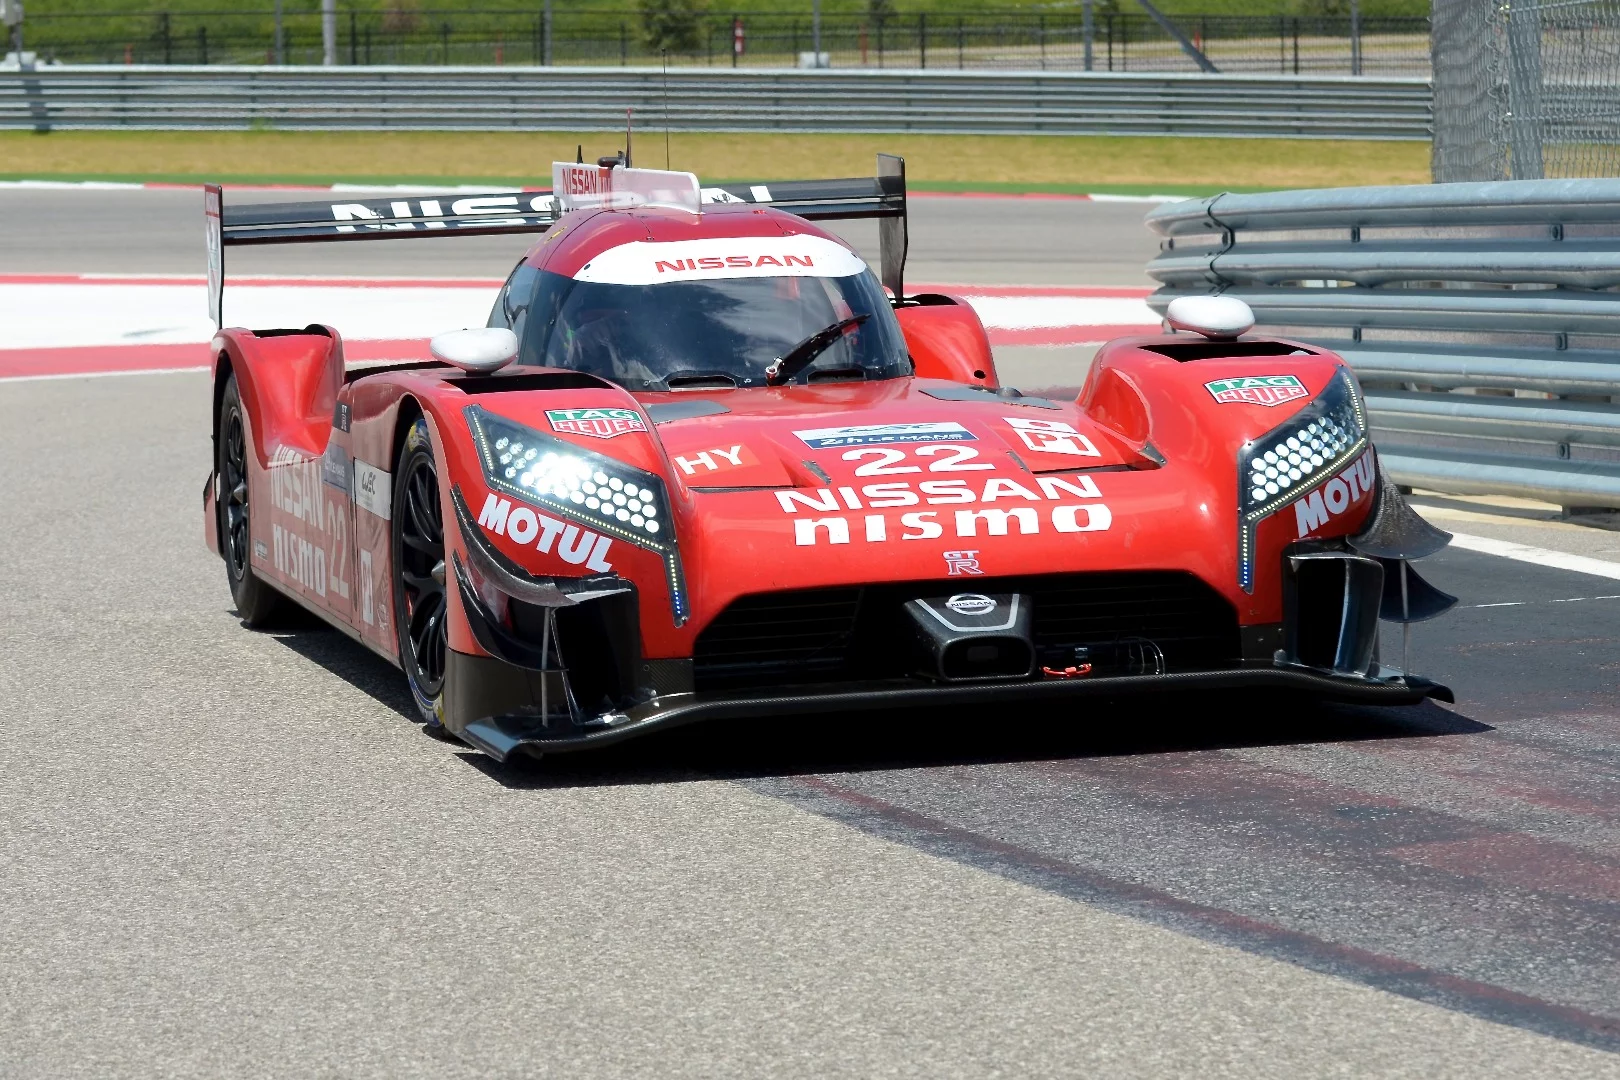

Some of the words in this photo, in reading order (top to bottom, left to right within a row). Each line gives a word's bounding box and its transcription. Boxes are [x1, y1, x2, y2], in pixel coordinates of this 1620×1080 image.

[563, 168, 597, 195] NISSAN
[655, 255, 814, 273] NISSAN
[1214, 376, 1291, 389] TAG
[1219, 387, 1302, 404] HEUER
[554, 409, 634, 420] TAG
[557, 420, 642, 435] HEUER
[1024, 431, 1090, 452] P1
[673, 444, 743, 476] HY
[842, 444, 997, 477] 22
[270, 443, 324, 531] NISSAN
[773, 474, 1103, 514] NISSAN
[478, 492, 613, 574] MOTUL
[794, 503, 1113, 546] nismo
[327, 500, 349, 599] 22
[942, 550, 979, 560] GT
[945, 558, 986, 576] R
